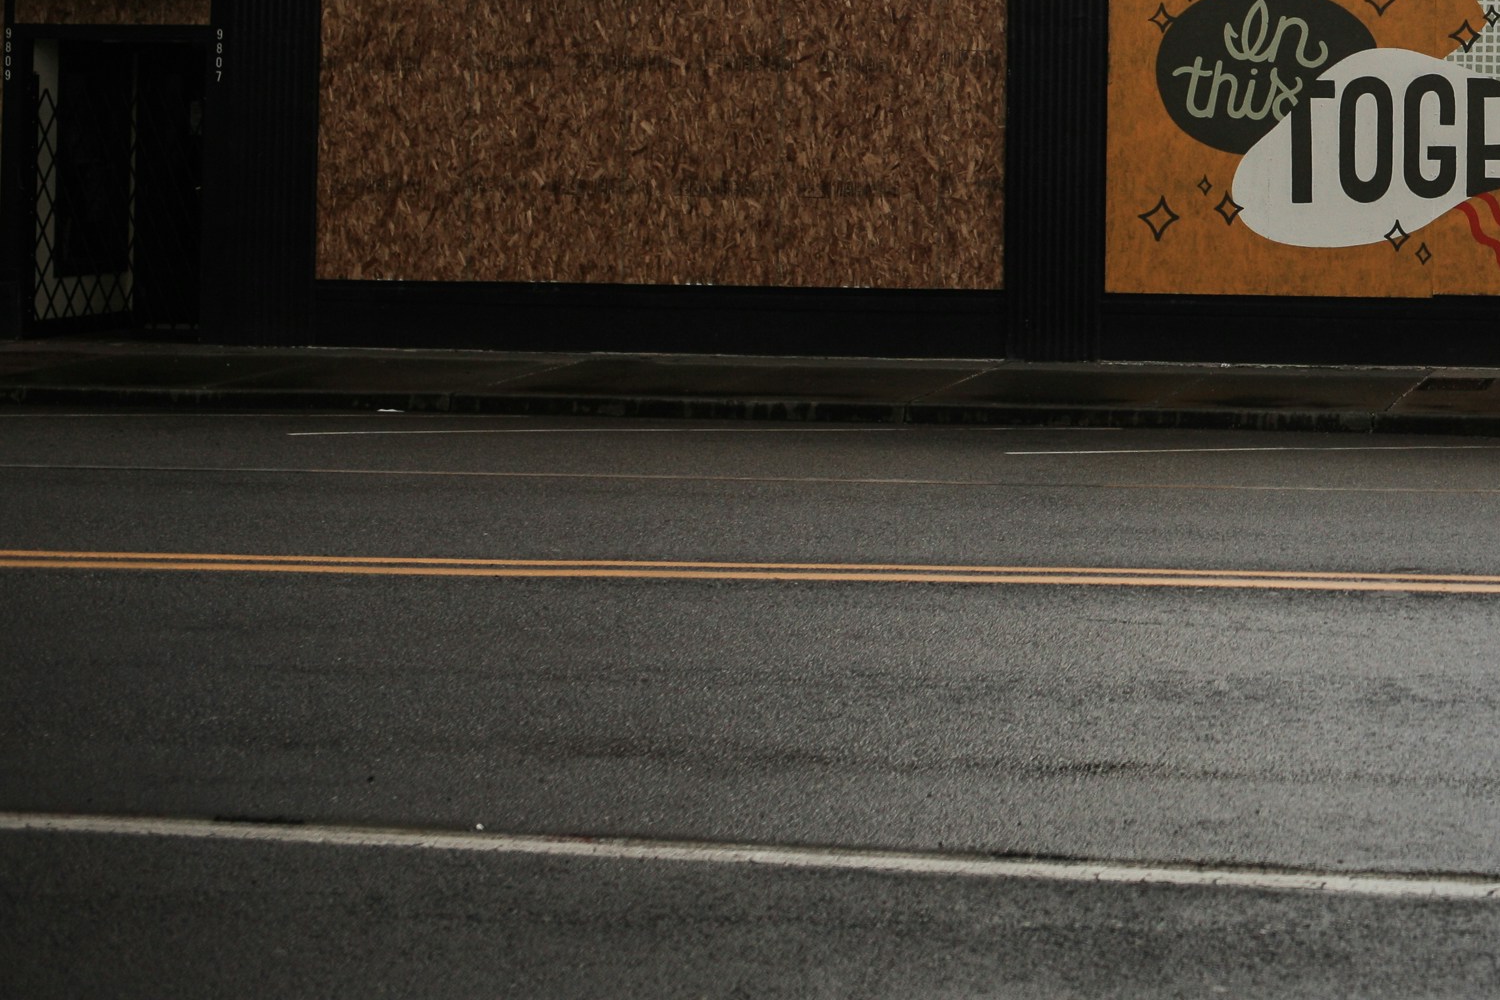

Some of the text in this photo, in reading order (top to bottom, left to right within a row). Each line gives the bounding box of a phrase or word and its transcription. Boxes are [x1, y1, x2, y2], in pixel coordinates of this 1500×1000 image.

[4, 27, 12, 81] 9809
[215, 28, 224, 82] 9807
[1172, 56, 1304, 123] this
